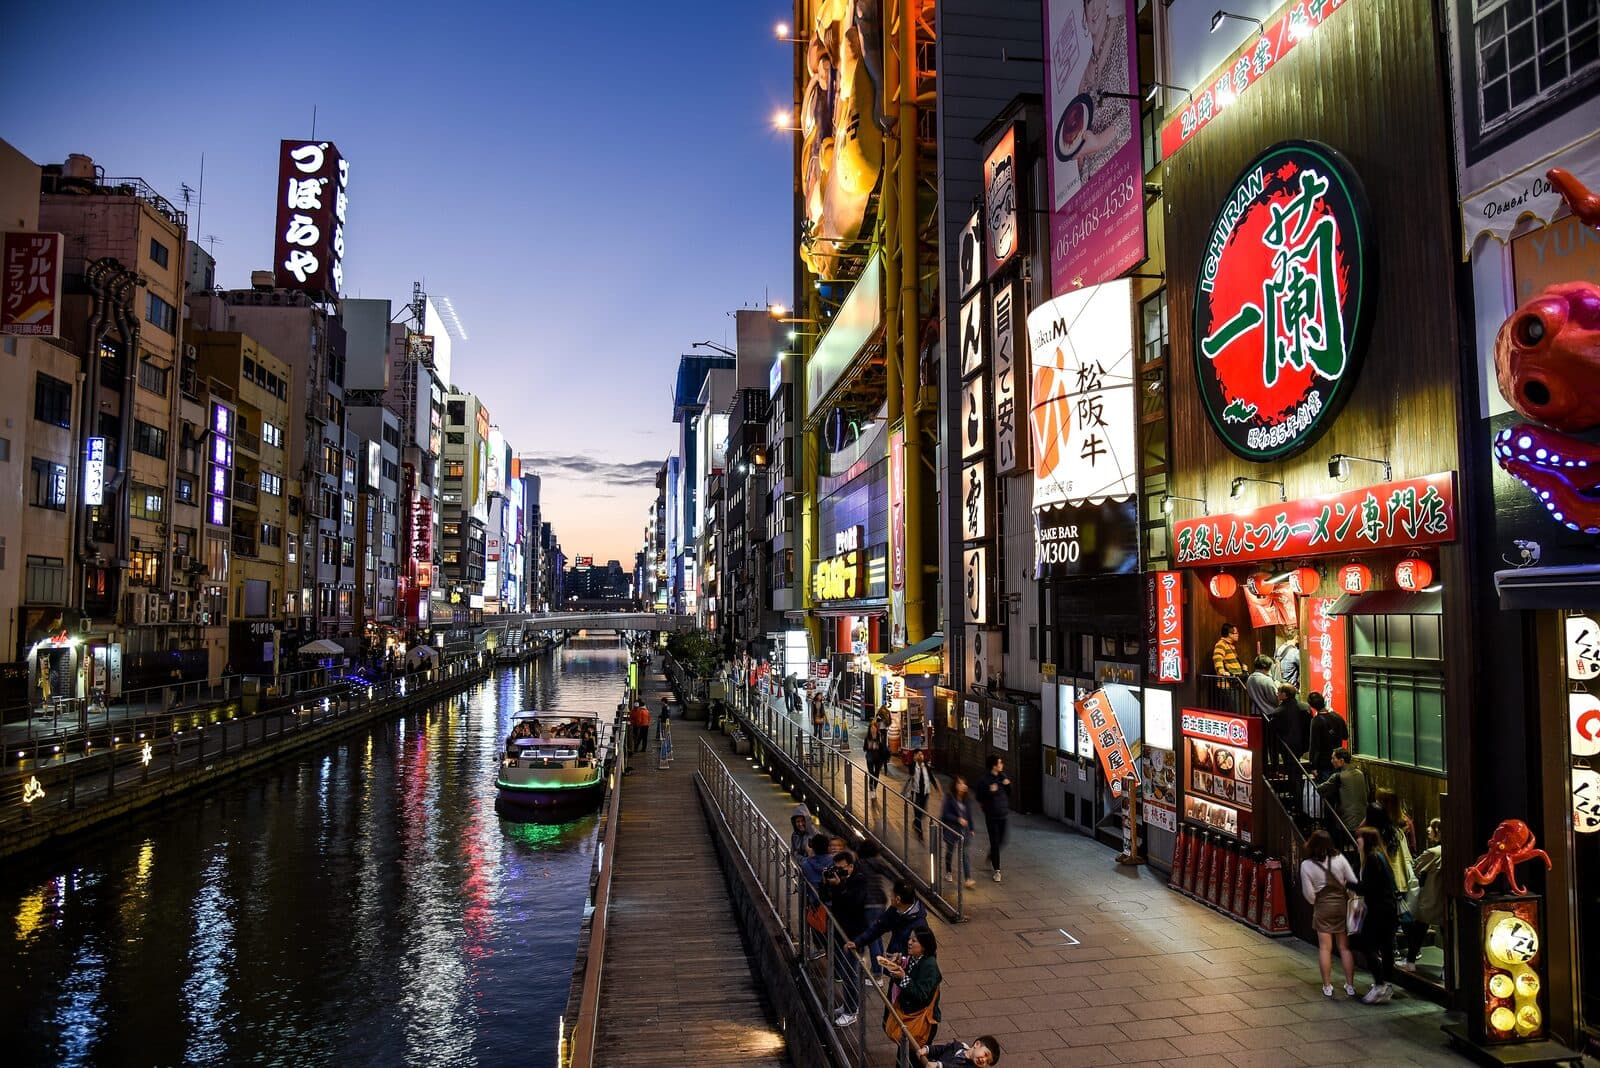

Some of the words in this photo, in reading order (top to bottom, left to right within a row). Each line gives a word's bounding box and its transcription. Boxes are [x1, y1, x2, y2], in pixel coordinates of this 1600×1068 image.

[285, 142, 328, 282] づぼらや
[1056, 176, 1134, 261] 06-6468-4538
[1201, 167, 1264, 292] ICHIRAN
[1483, 189, 1529, 219] Dessert
[7, 247, 28, 309] ドラッグ
[27, 238, 51, 294] ツルハ
[1201, 169, 1346, 388] 一蘭
[997, 293, 1013, 466] 旨くて安い
[1075, 359, 1109, 467] 松阪牛
[1247, 390, 1322, 450] 昭和35年創業
[1040, 541, 1079, 564] M300
[1041, 527, 1057, 540] SAKE
[1058, 526, 1079, 538] BAR
[1177, 486, 1449, 562] 天然とんこつラーメン専門店
[1345, 567, 1361, 592] 一蘭
[1398, 561, 1416, 589] 一蘭
[1160, 574, 1181, 680] ラーメン一蘭
[1089, 709, 1124, 770] 居酒屋
[1182, 715, 1229, 738] お土産販売所
